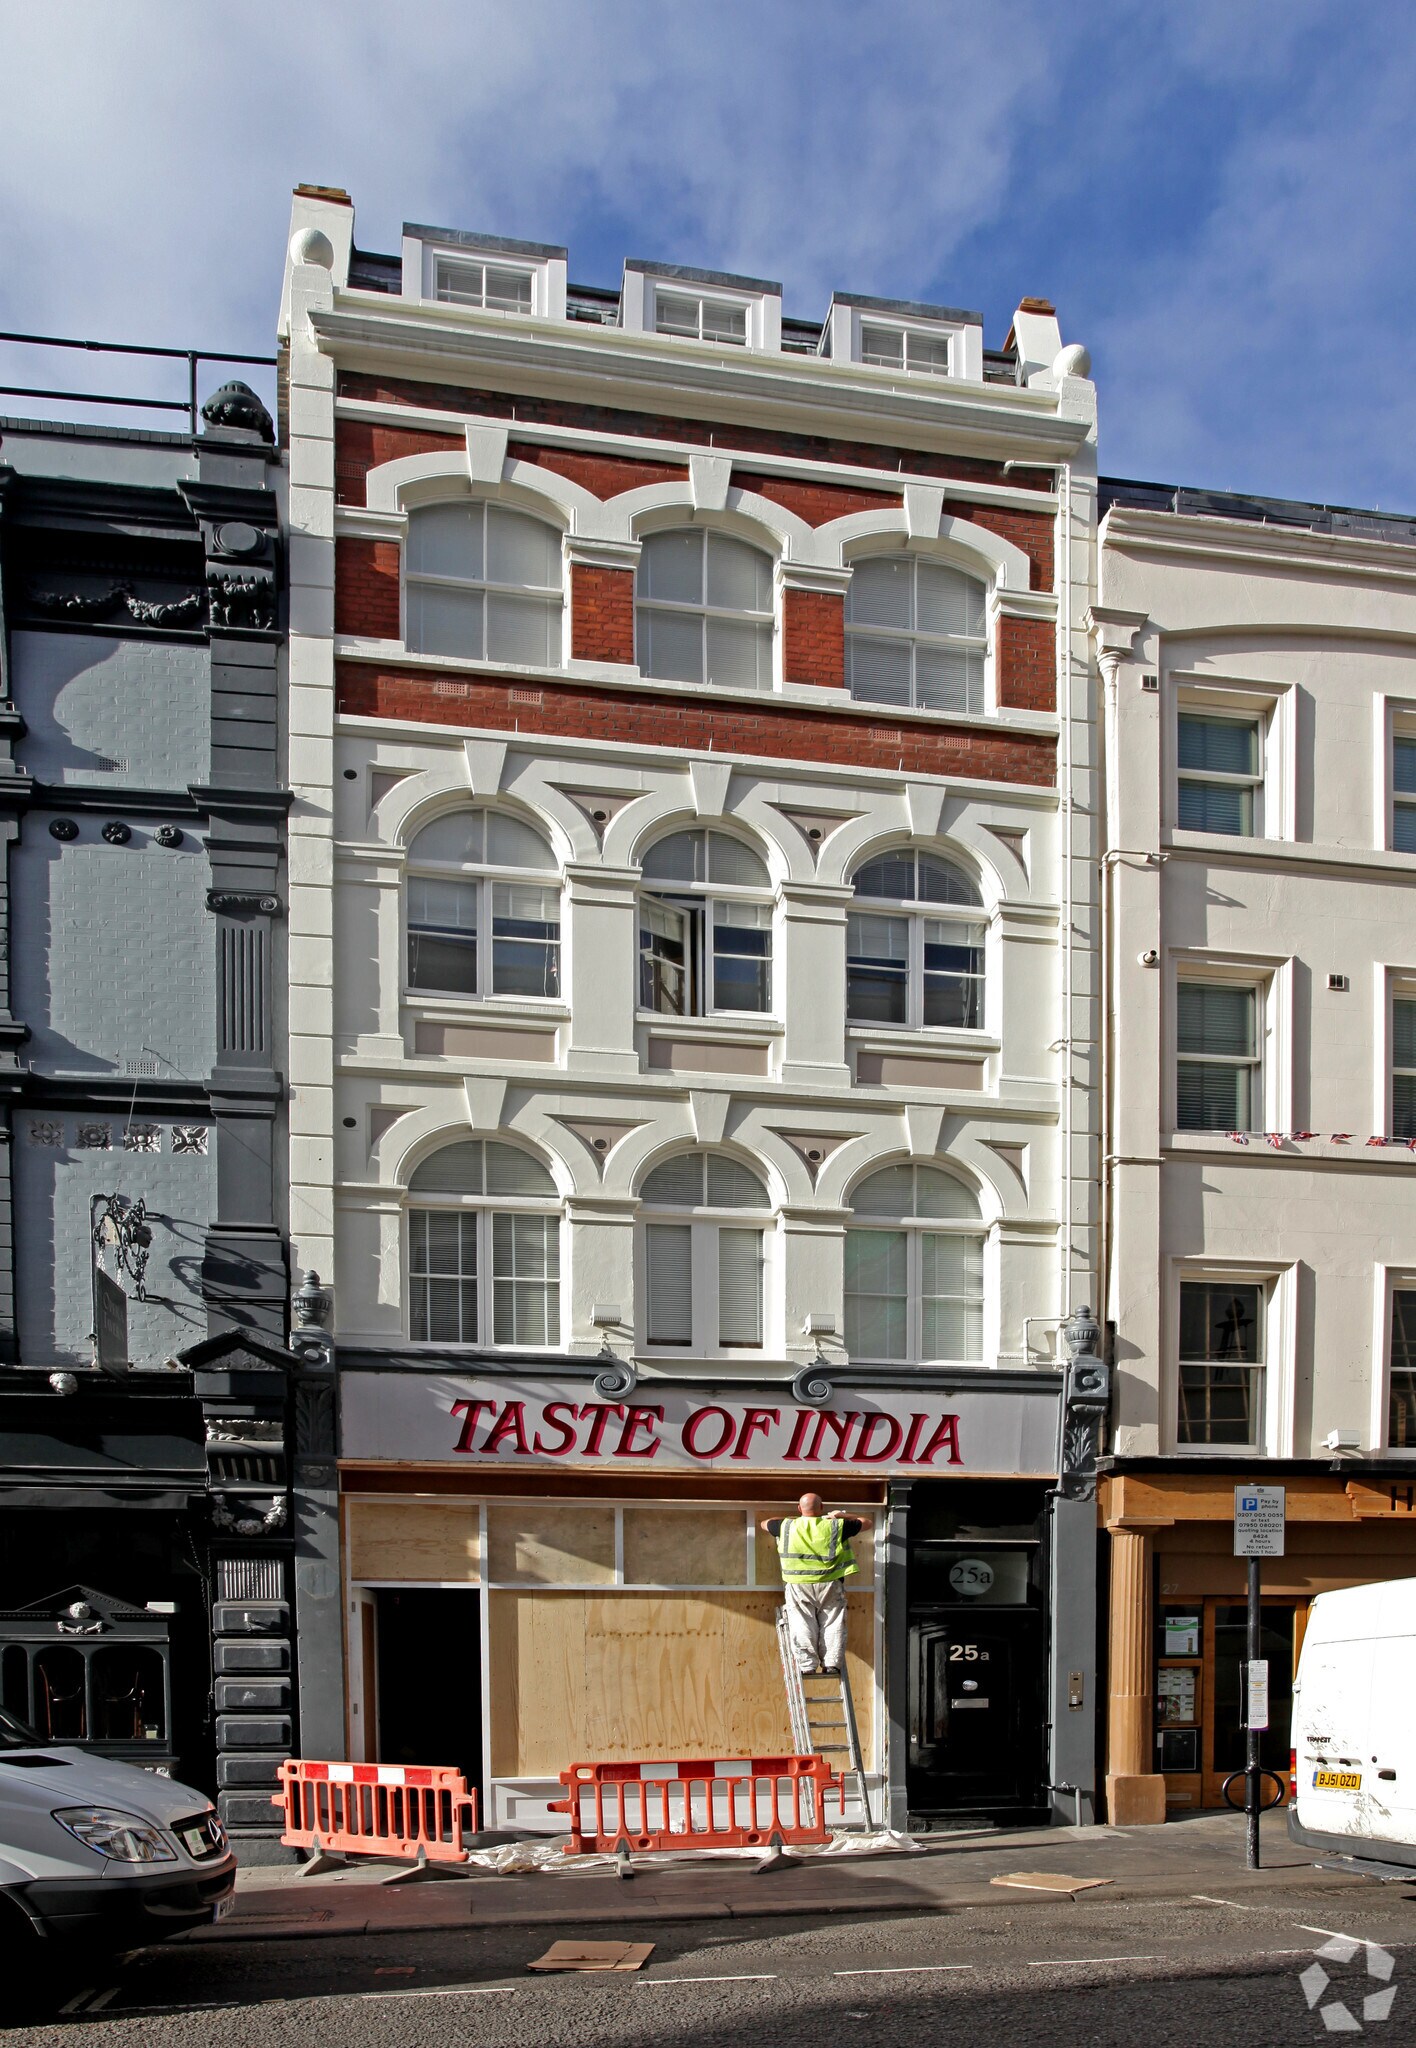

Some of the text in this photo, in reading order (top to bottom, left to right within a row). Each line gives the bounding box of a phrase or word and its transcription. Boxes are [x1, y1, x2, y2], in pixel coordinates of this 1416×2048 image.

[450, 1399, 966, 1466] TASTE OF INDIA
[951, 1566, 992, 1584] 25a
[1161, 1583, 1179, 1595] 27
[949, 1644, 990, 1661] 25a
[1319, 1773, 1339, 1785] BJ51
